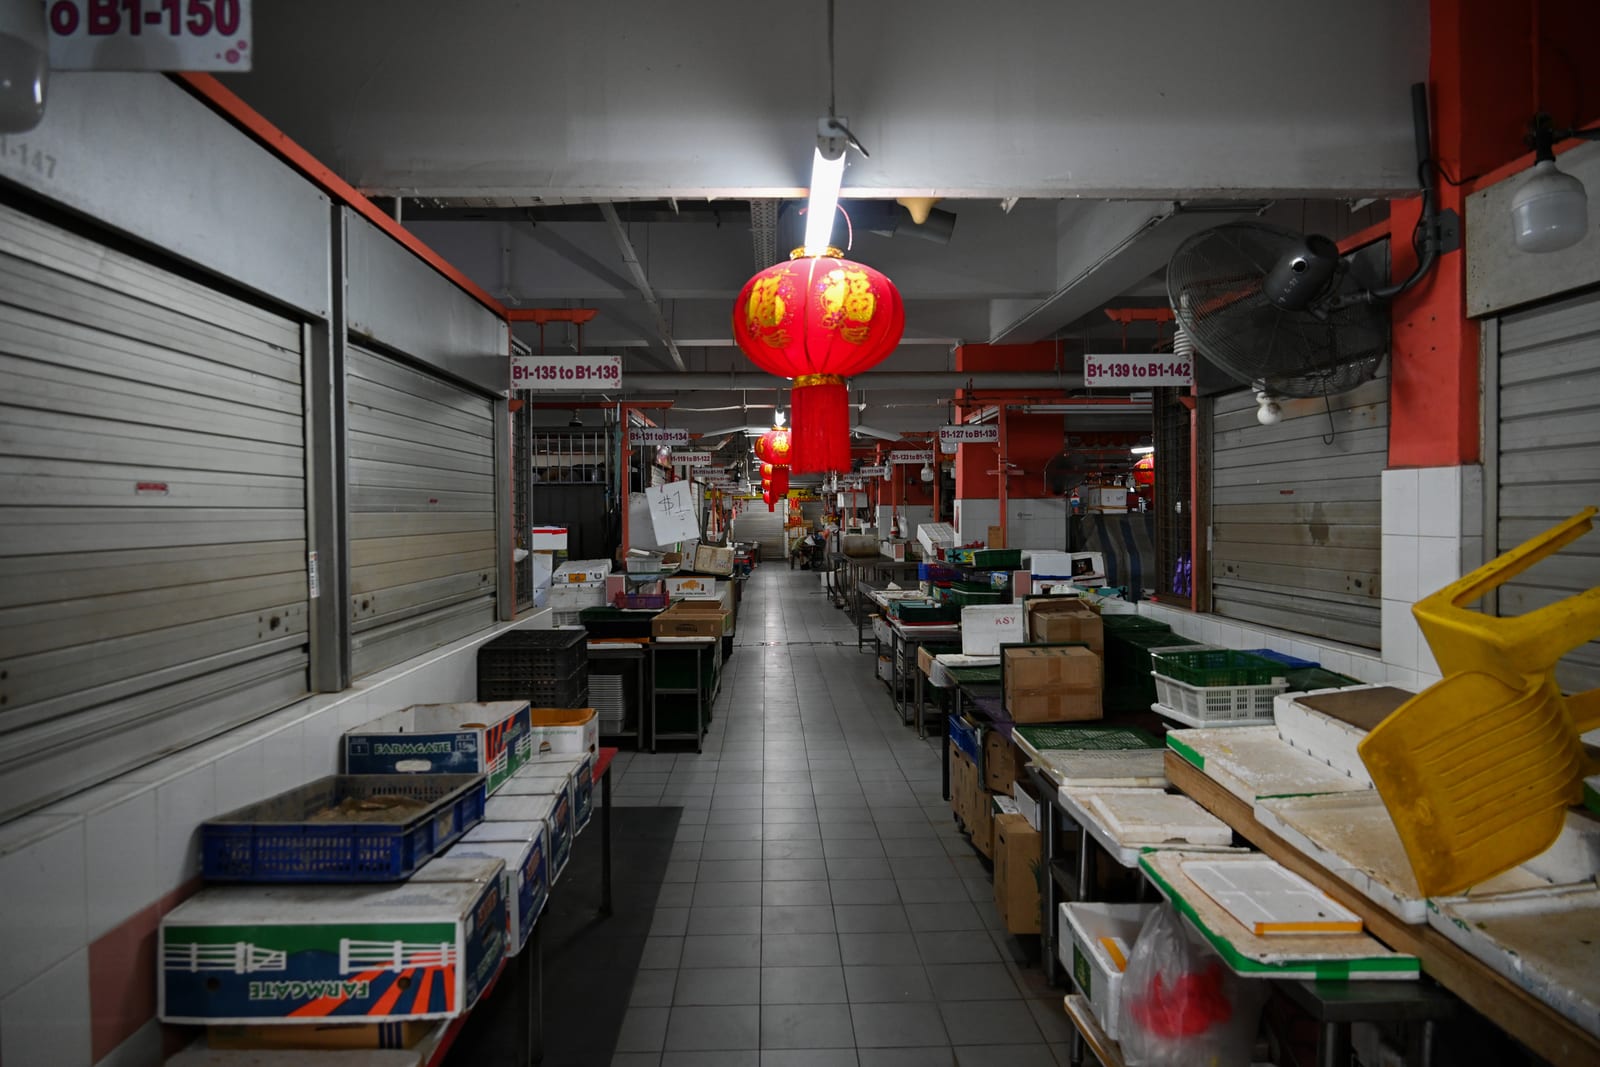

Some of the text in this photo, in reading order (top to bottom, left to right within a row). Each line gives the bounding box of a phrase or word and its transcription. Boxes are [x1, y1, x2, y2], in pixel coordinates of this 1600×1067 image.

[51, 0, 240, 37] o B1-150
[513, 365, 619, 379] B1-135 to B1-138
[1087, 363, 1191, 377] B1-139 to B1-142
[630, 432, 687, 440] B1-131 to B1-134
[941, 429, 998, 438] B1-127 to B1-130
[995, 615, 1016, 625] KSY
[373, 741, 452, 756] FARMGATE
[248, 980, 370, 1000] FARMGATE
